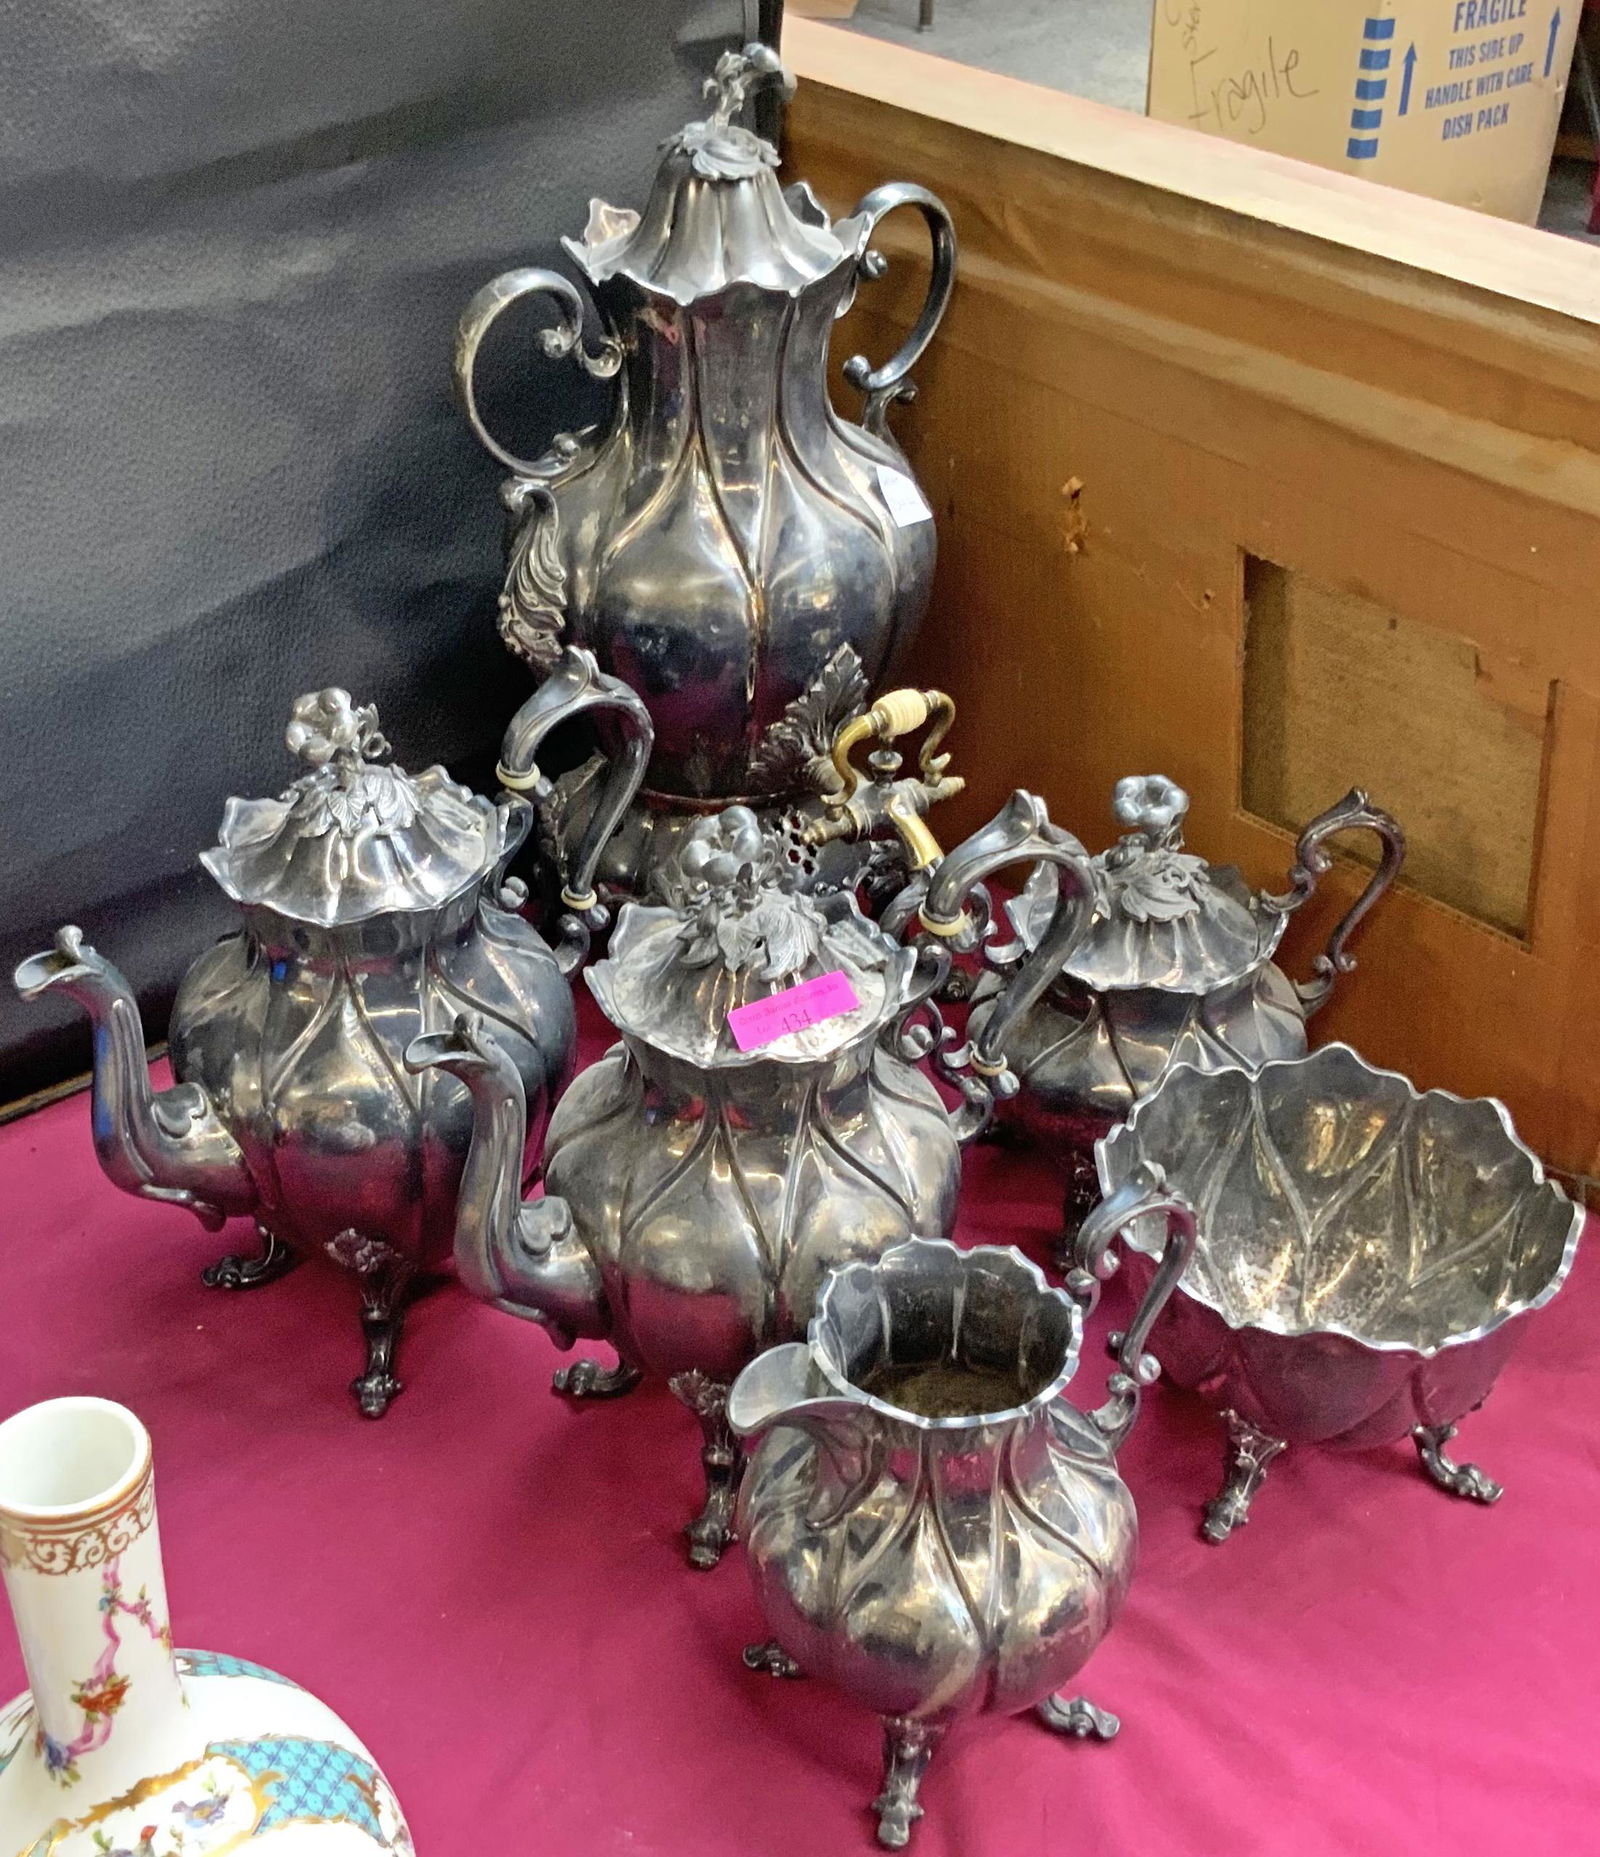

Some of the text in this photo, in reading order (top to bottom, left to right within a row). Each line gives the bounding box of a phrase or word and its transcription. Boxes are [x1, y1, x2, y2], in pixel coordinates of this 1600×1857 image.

[1453, 0, 1527, 33] FRAGILE
[1448, 32, 1524, 70] THIS SIDE UP
[1188, 35, 1320, 134] Fragile
[1425, 62, 1534, 109] HANDLE WITH CARE
[1442, 102, 1510, 141] DISH PACK
